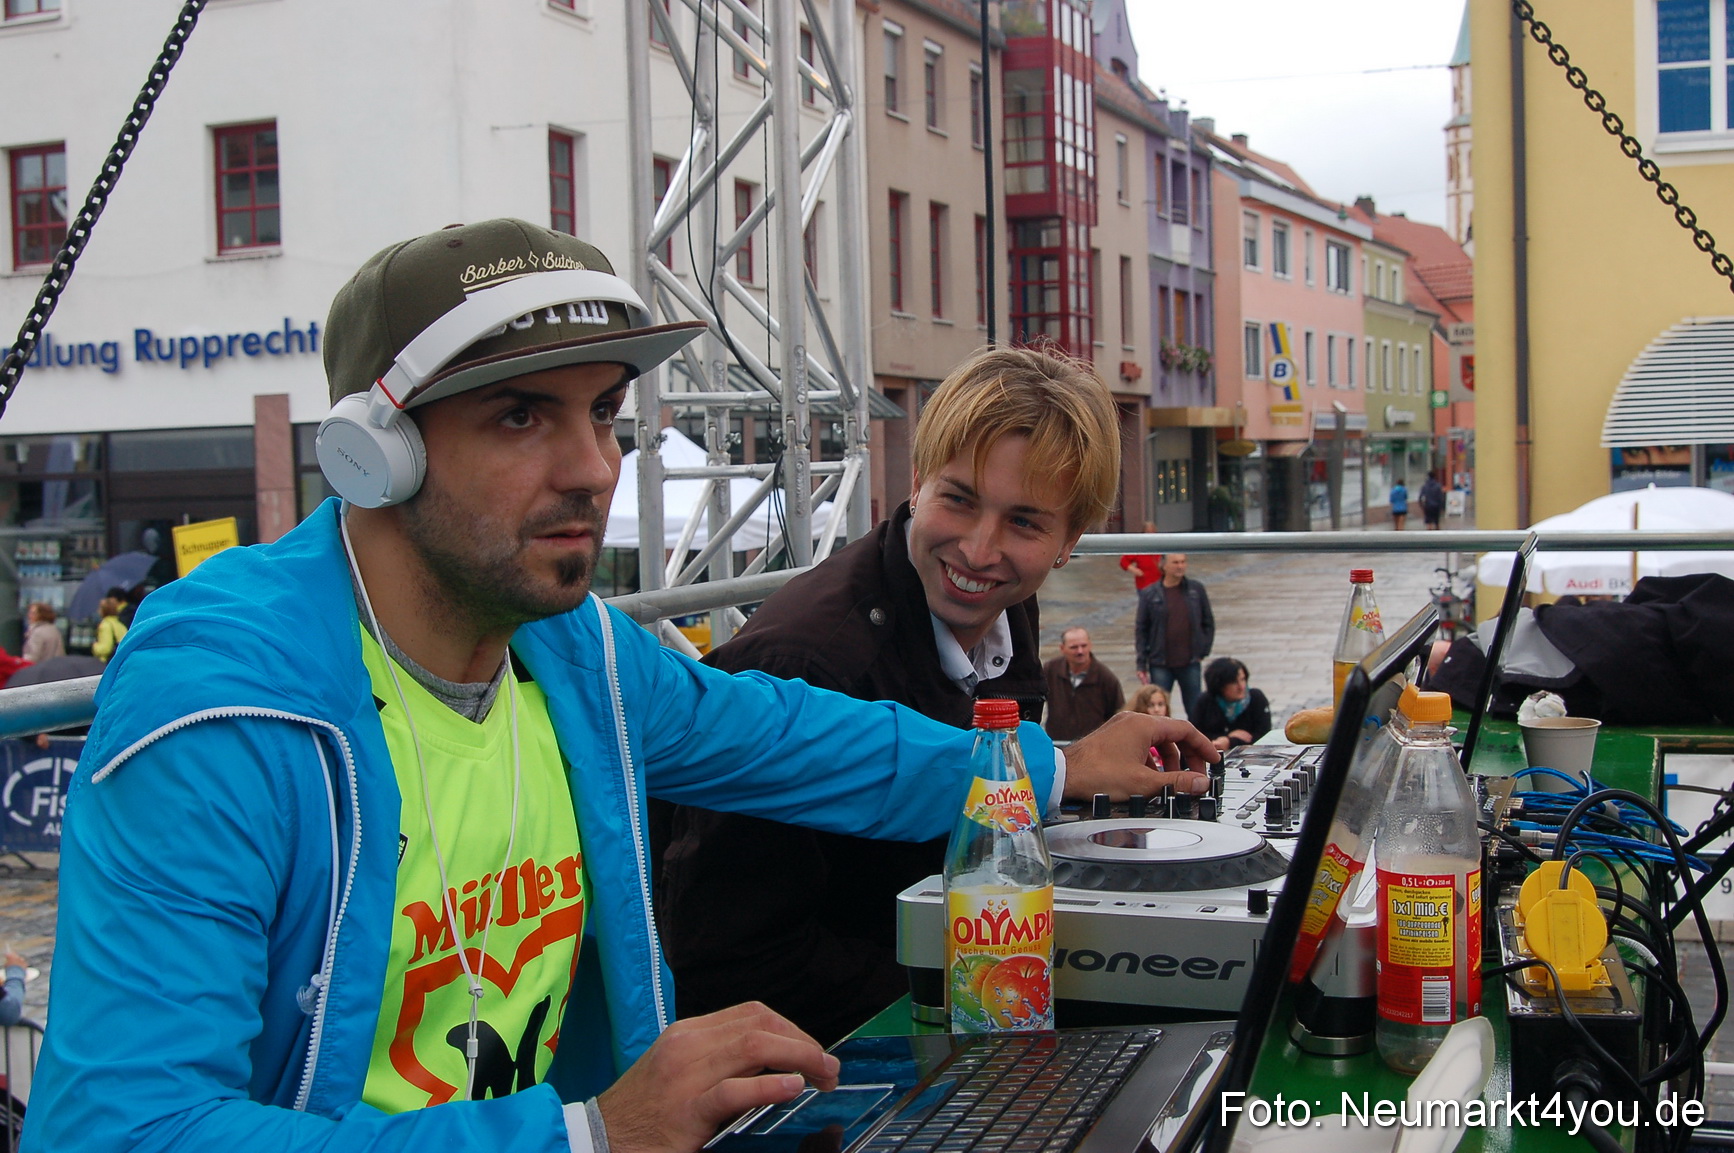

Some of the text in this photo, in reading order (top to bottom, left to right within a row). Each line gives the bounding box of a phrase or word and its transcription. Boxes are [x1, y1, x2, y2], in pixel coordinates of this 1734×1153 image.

[460, 256, 527, 284] Barber
[134, 317, 320, 369] Rupprecht
[1273, 363, 1288, 379] B
[336, 447, 370, 477] SONY
[1566, 578, 1603, 590] Audi
[1401, 877, 1413, 887] 0,5
[1414, 878, 1419, 887] L
[402, 853, 582, 965] Müller
[989, 946, 1006, 955] und
[1011, 943, 1041, 954] Genuss
[1054, 941, 1246, 980] ioneer
